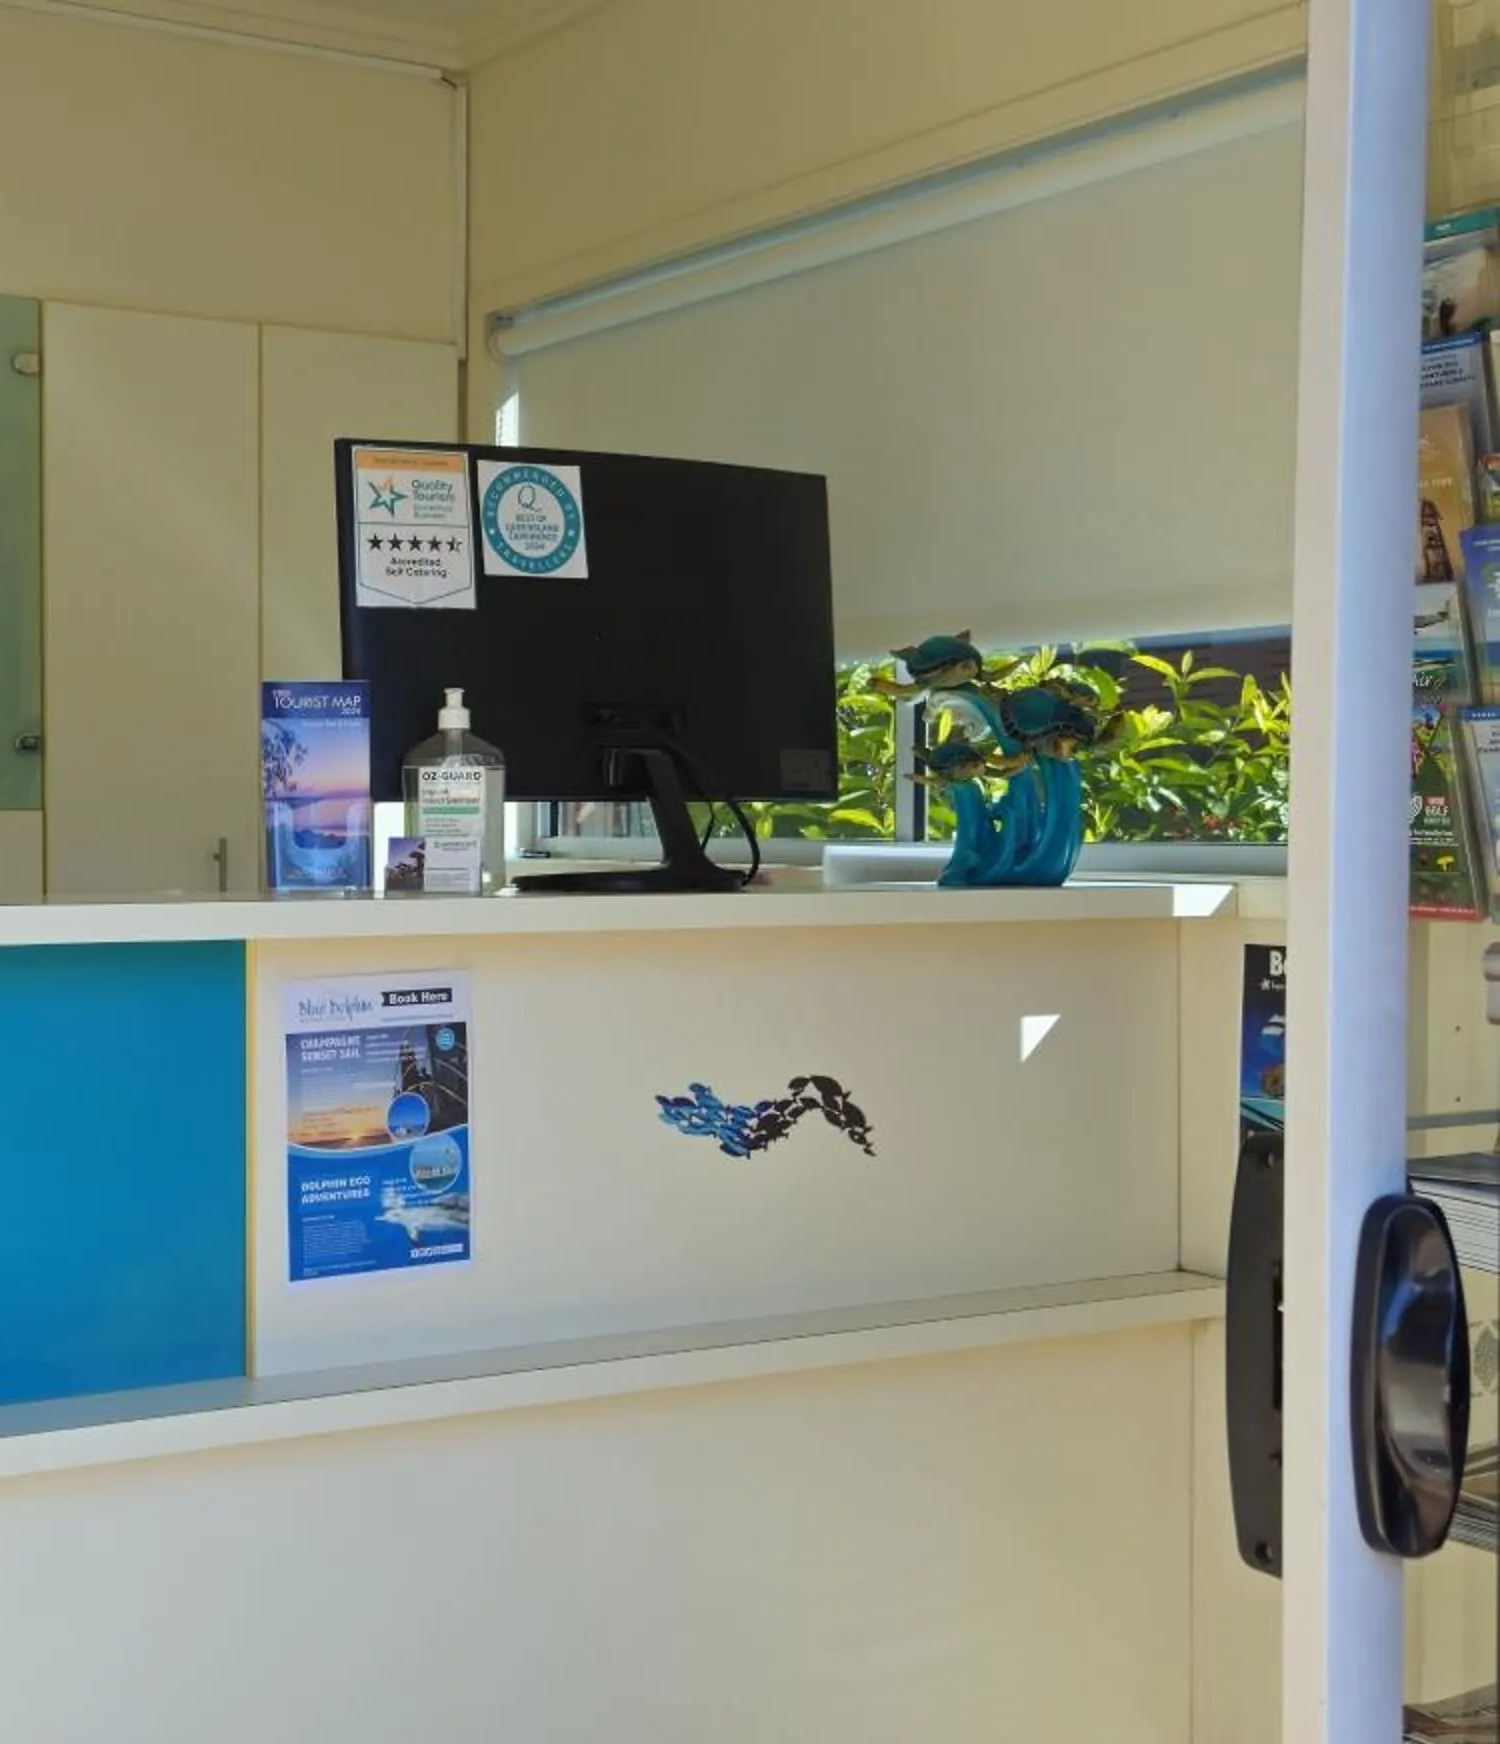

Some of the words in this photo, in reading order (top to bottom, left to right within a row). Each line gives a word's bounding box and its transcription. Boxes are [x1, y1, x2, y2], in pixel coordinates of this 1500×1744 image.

[411, 479, 453, 492] Quality
[413, 490, 455, 502] Tourism
[390, 557, 441, 566] Accredited
[386, 568, 403, 577] Self
[405, 568, 448, 579] Catering
[274, 695, 329, 709] TOURIST
[331, 695, 361, 709] MAP
[421, 771, 482, 781] OZ-GUARD
[389, 992, 418, 1005] Book
[421, 990, 449, 1003] Here
[301, 1050, 338, 1062] SUNSET
[301, 1179, 348, 1192] DOLPHIN
[350, 1175, 371, 1186] ECO
[301, 1187, 371, 1204] ADVENTURES
